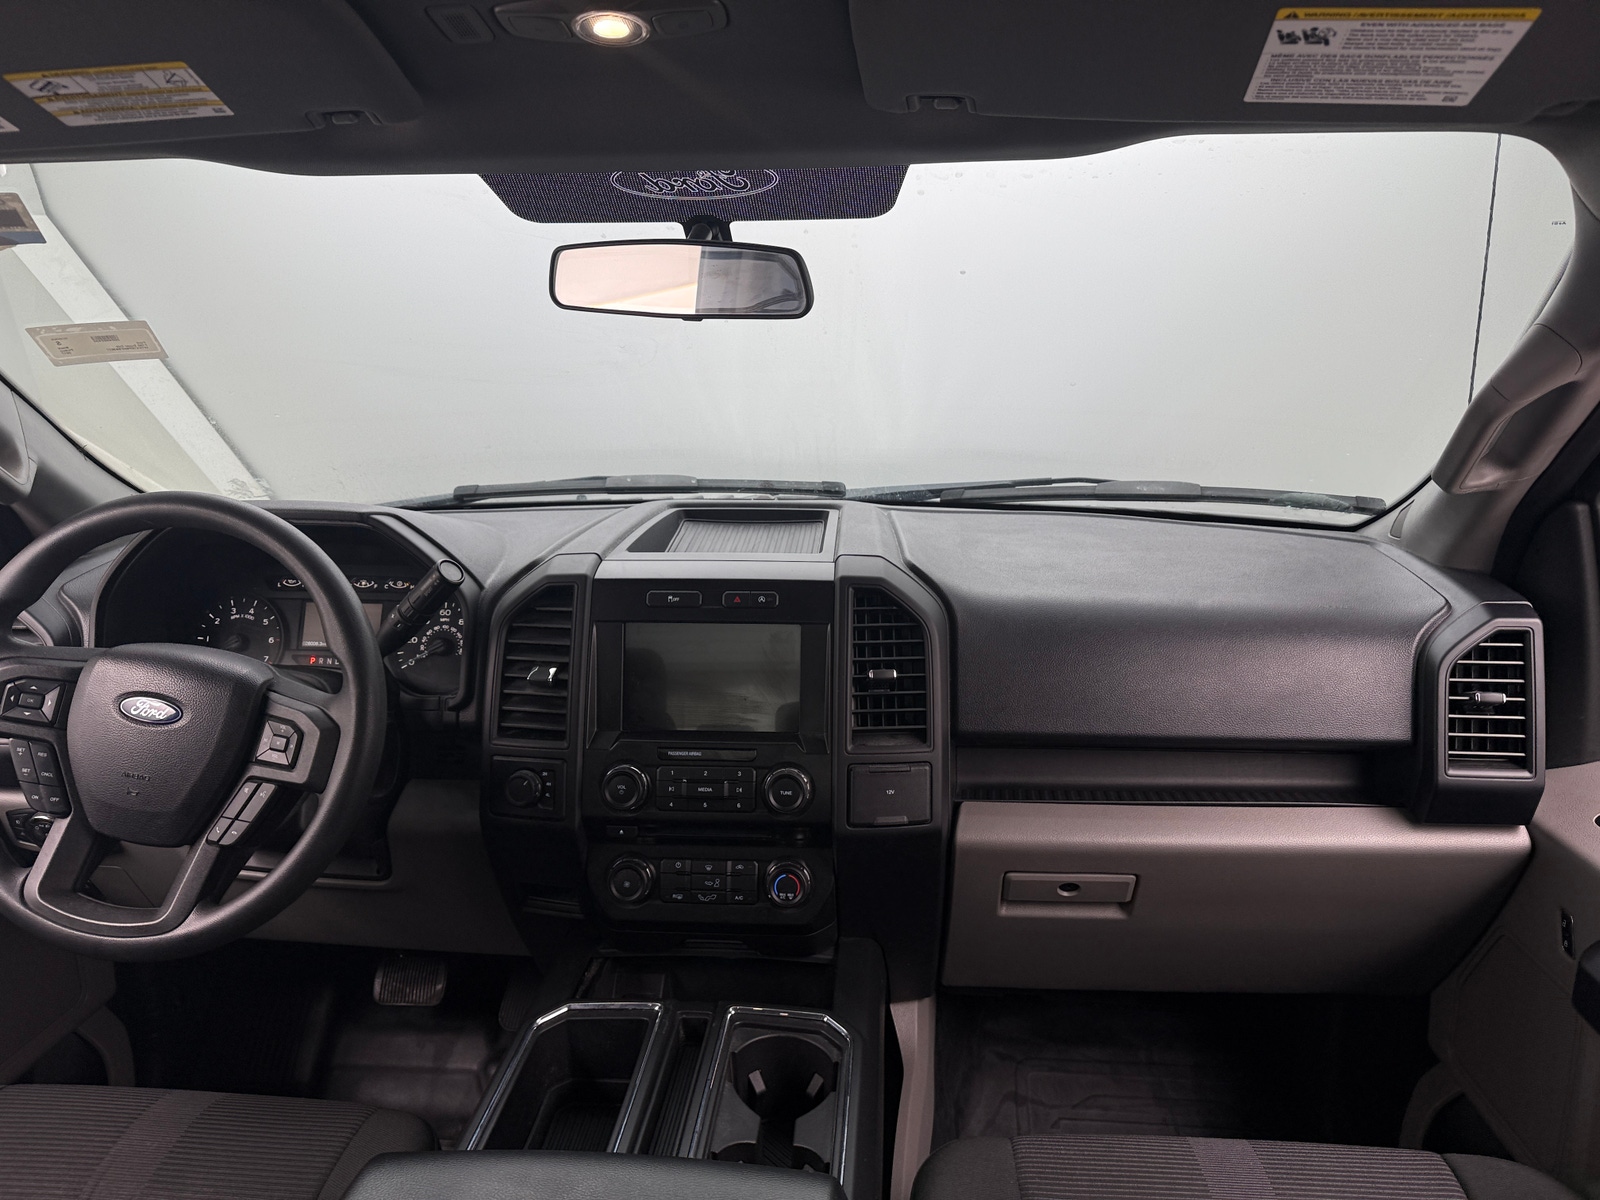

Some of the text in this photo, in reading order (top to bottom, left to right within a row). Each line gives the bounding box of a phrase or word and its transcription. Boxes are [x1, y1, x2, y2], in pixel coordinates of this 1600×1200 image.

[230, 607, 237, 615] 3
[248, 607, 255, 615] 4
[440, 609, 452, 617] 60
[214, 617, 221, 625] 2
[262, 618, 269, 626] 5
[268, 636, 275, 644] 6
[263, 655, 270, 663] 7
[310, 656, 316, 665] P
[318, 657, 324, 665] R
[326, 657, 333, 665] N
[130, 699, 168, 720] Ford
